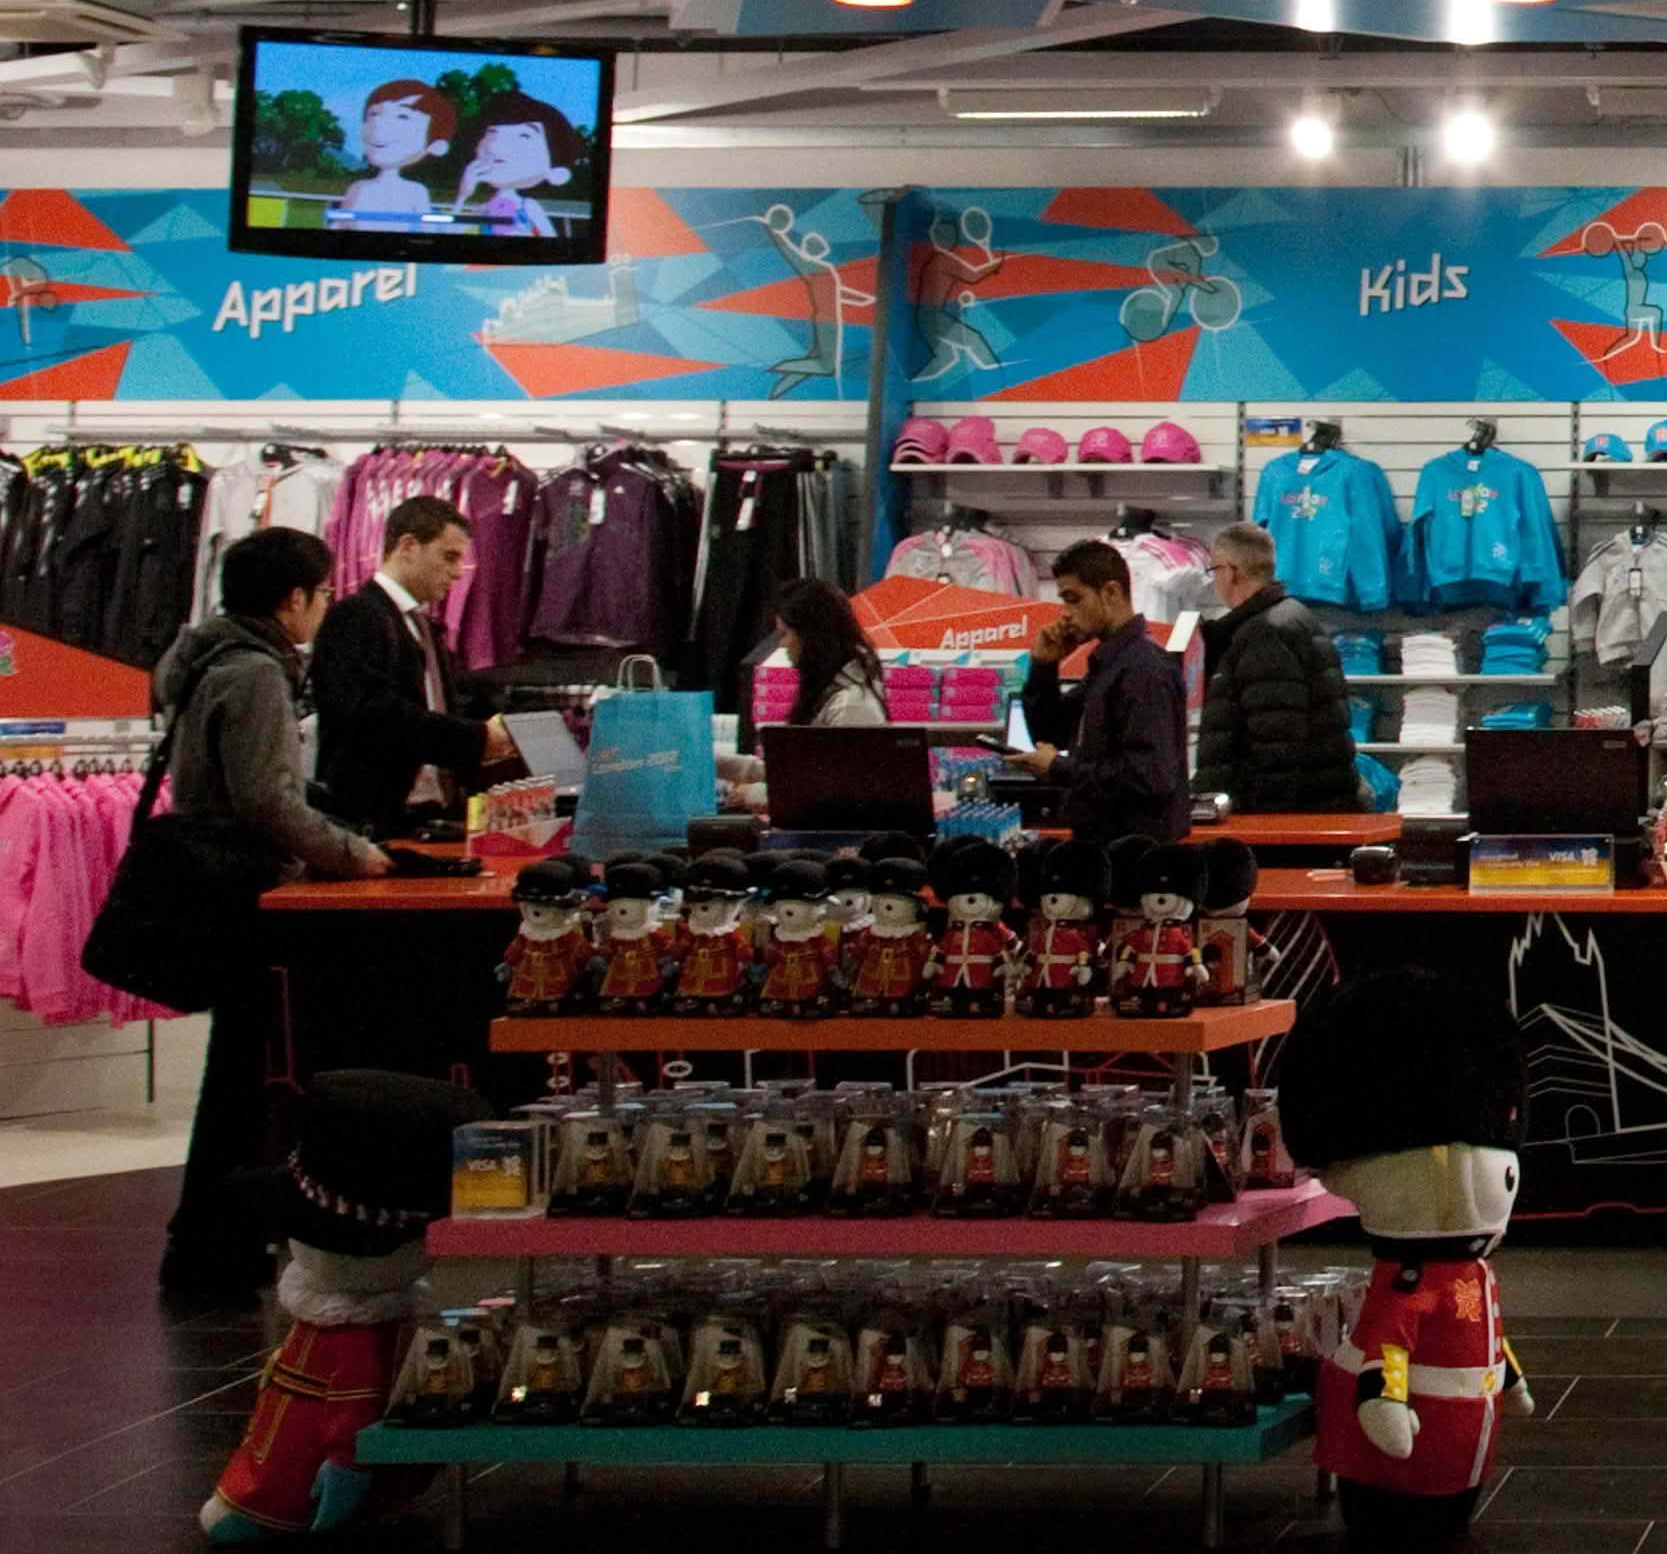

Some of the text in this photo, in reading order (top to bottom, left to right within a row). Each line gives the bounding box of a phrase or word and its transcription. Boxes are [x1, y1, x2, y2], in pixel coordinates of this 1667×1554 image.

[211, 262, 418, 340] Apparel
[1359, 252, 1471, 317] Kids
[939, 613, 1029, 651] Apparel
[1547, 851, 1577, 862] VISA
